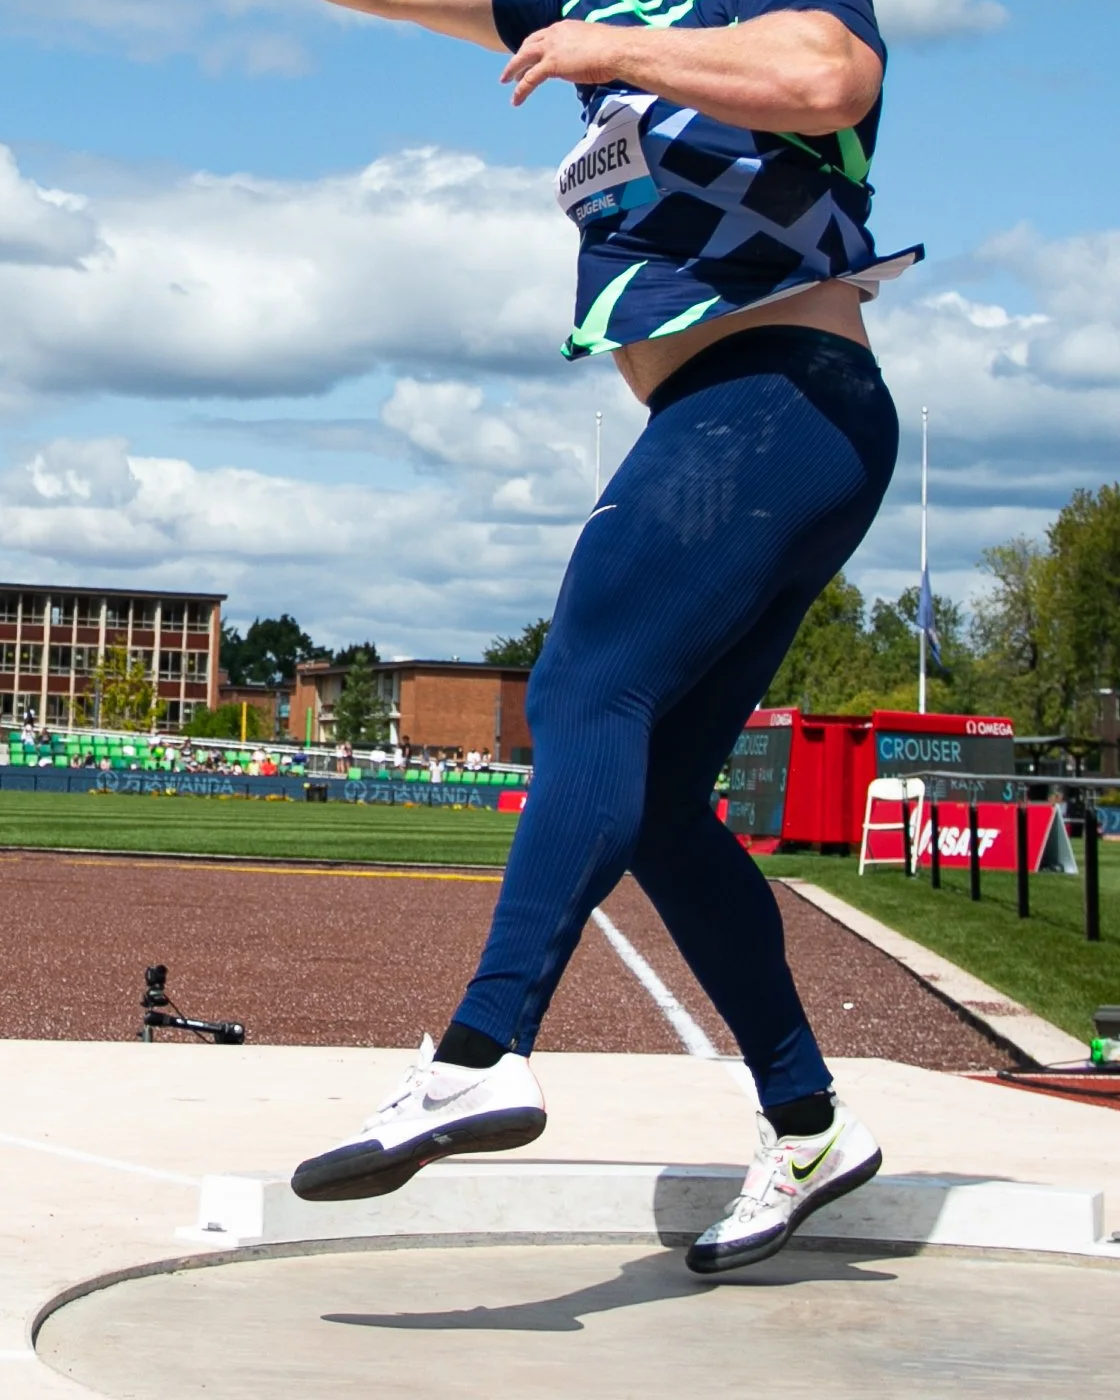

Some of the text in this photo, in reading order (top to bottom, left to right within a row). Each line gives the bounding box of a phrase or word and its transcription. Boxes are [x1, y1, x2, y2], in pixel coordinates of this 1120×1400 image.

[560, 138, 630, 195] CROUSER
[576, 193, 616, 219] EUGENE
[977, 720, 1014, 736] OMEGA
[880, 737, 962, 762] CROUSER
[163, 775, 235, 794] WANDA
[412, 785, 482, 804] WANDA
